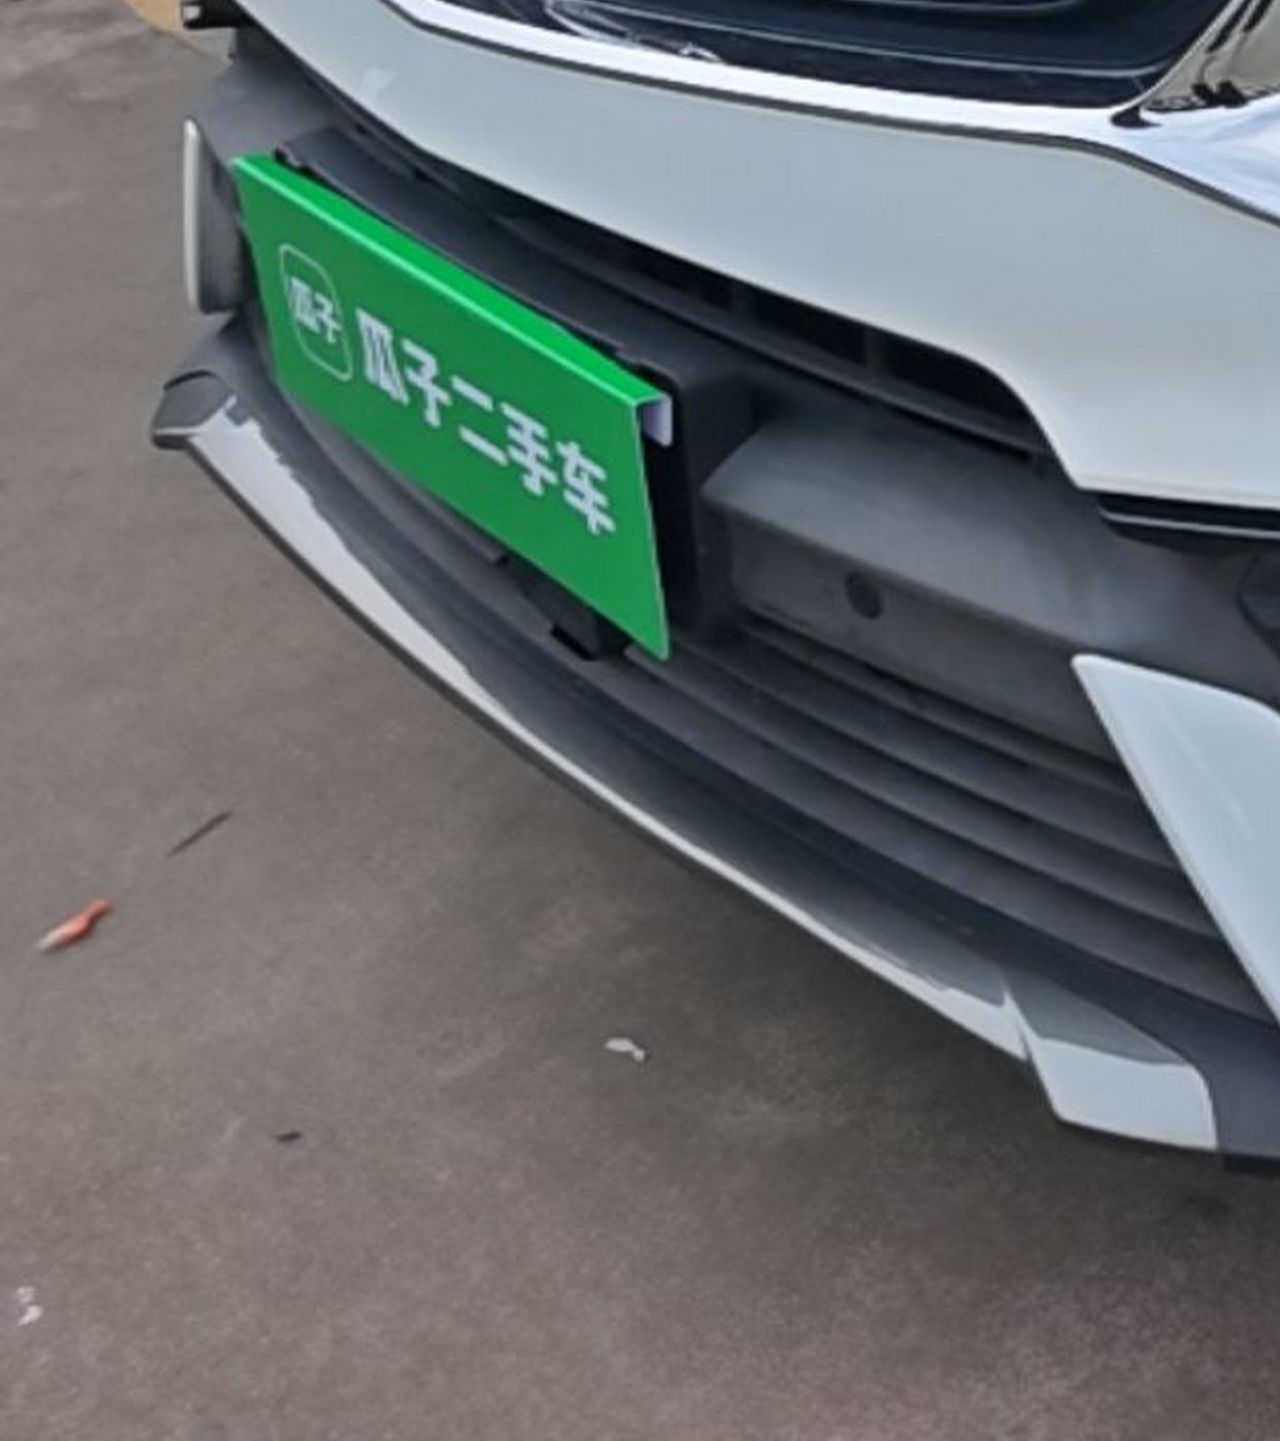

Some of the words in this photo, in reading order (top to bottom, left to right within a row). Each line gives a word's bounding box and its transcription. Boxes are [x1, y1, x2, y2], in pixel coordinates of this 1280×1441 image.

[356, 307, 615, 535] 瓜子二手车
